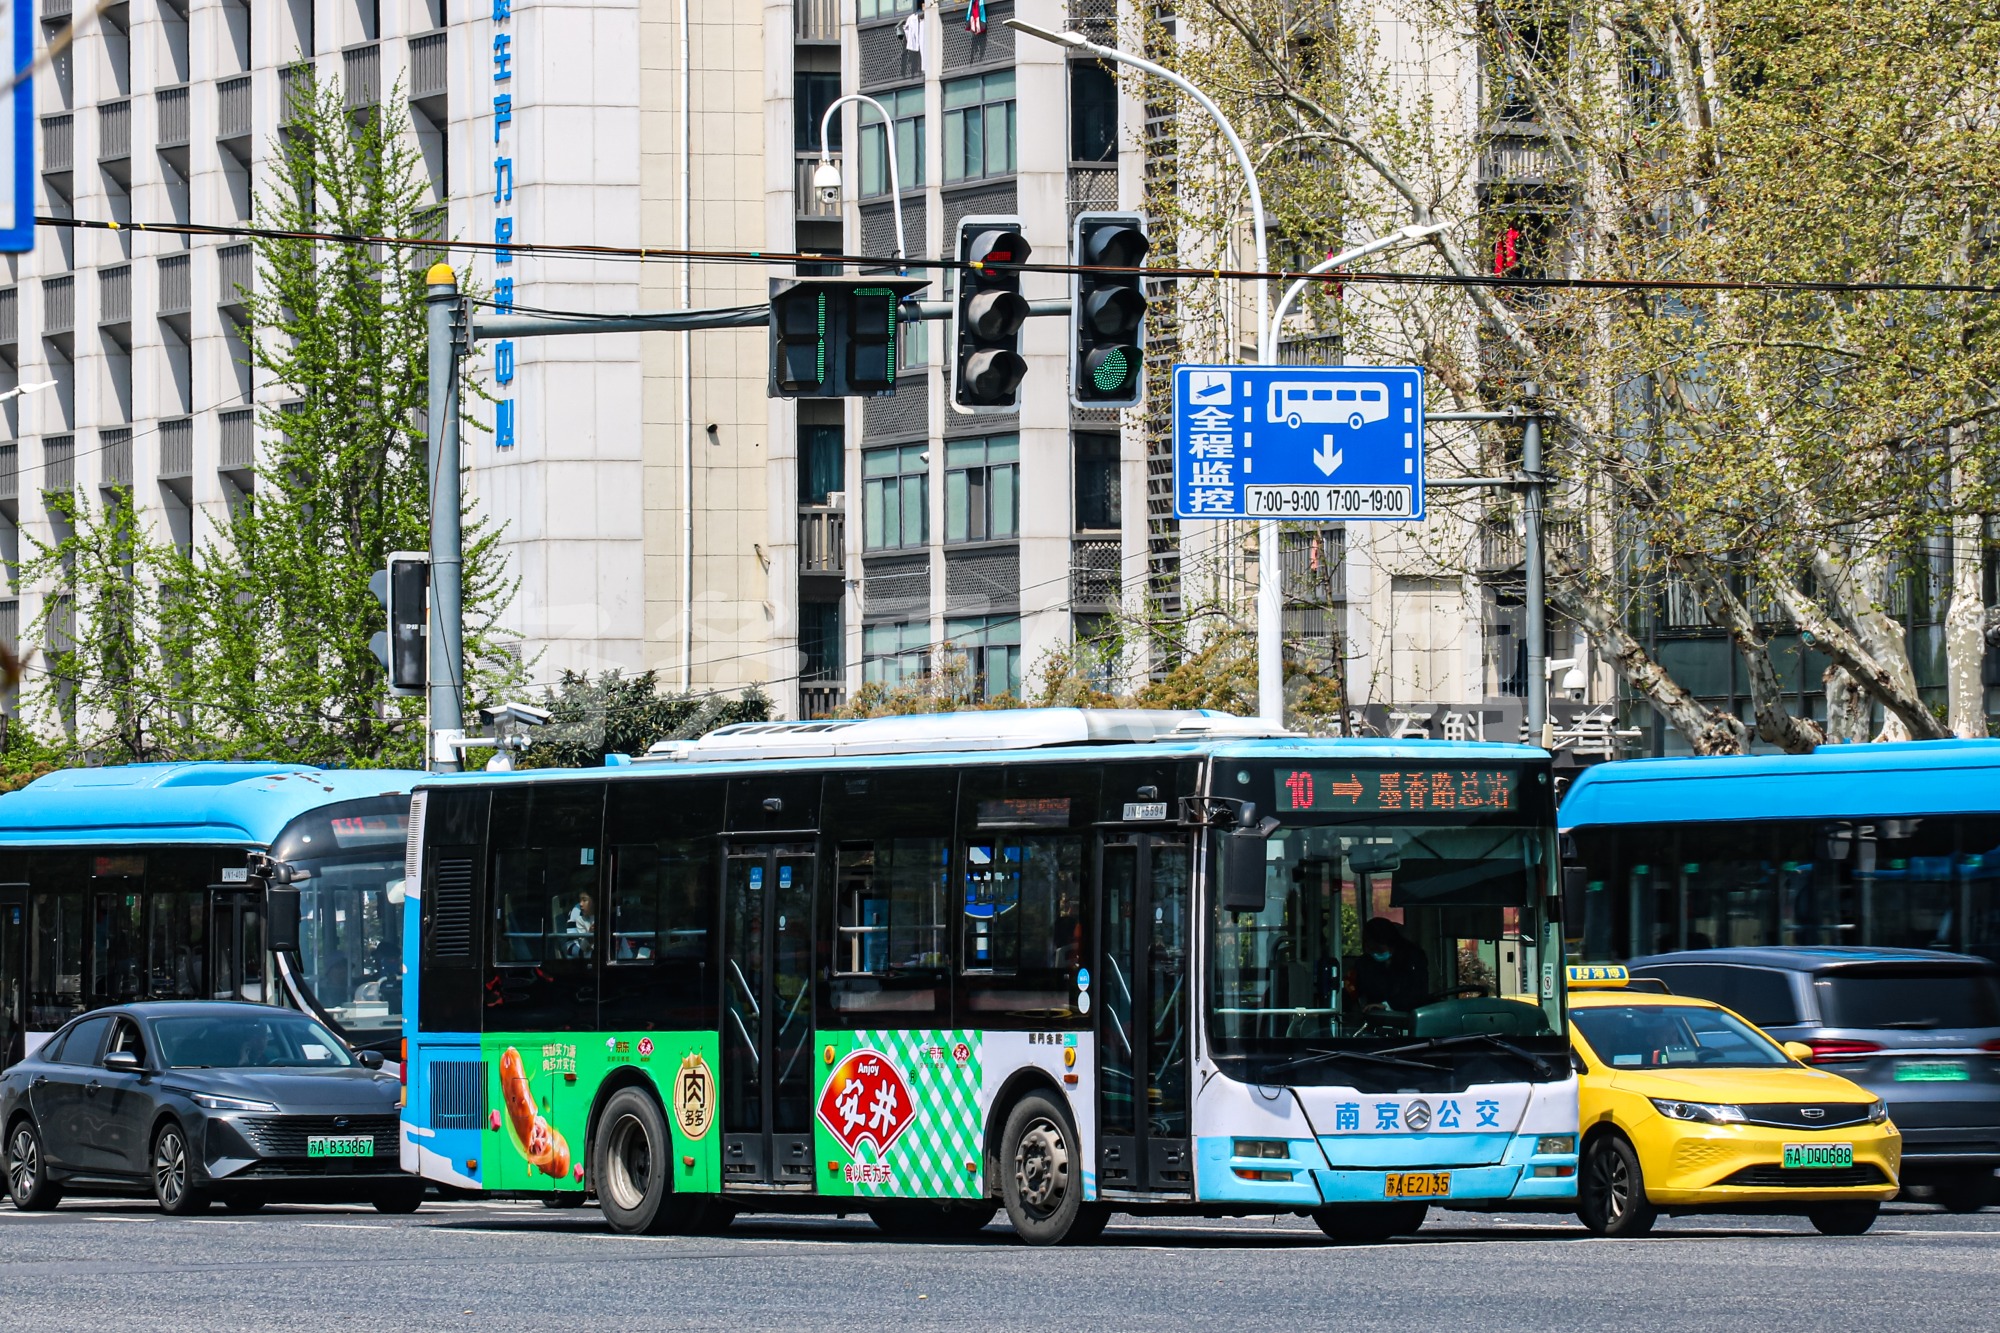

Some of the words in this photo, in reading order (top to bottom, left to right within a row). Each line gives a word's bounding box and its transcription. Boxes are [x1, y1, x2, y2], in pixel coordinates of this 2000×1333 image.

[1188, 406, 1235, 513] 全程监控
[1254, 490, 1320, 512] 7:00-9:00
[1327, 489, 1403, 512] 17:00-19:00
[1285, 771, 1313, 809] 10
[1378, 771, 1510, 809] 墨香路总站
[1125, 804, 1164, 818] JN4-5594
[857, 1060, 880, 1077] Anjoy
[683, 1069, 705, 1108] 肉
[685, 1109, 704, 1127] 多多
[835, 1079, 898, 1137] 安井
[1335, 1100, 1500, 1130] 南京公交
[844, 1164, 892, 1183] 食以民为天
